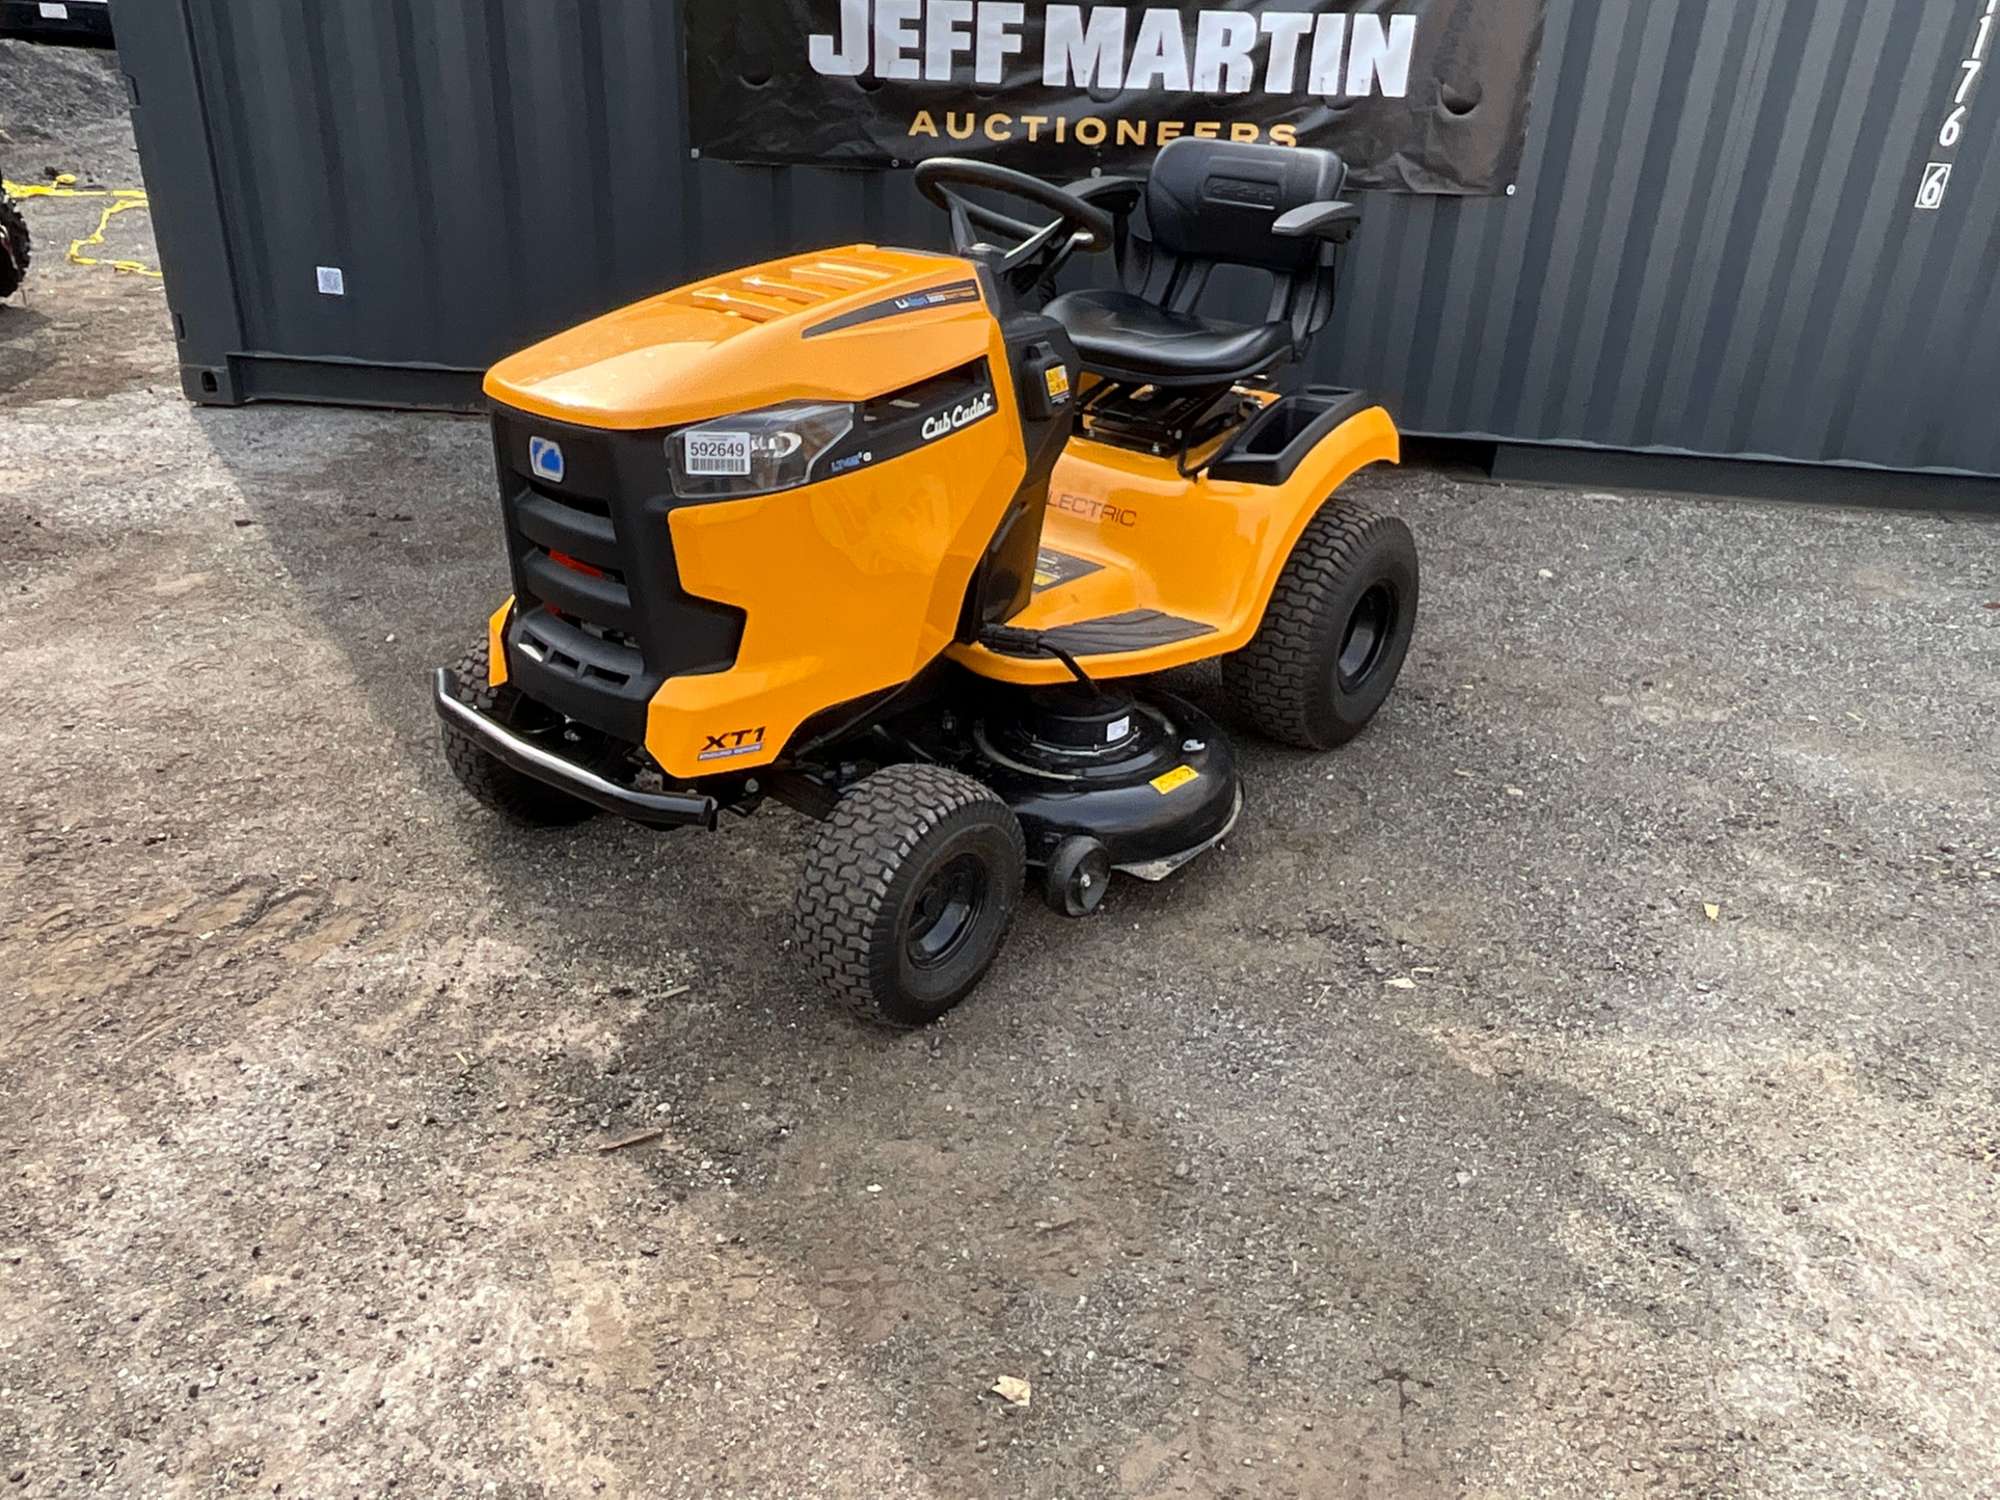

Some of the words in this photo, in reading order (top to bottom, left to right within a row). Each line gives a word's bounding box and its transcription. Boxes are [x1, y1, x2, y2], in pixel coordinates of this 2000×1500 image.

[809, 0, 1024, 83] JEFF
[1043, 4, 1416, 98] MARTIN
[922, 411, 951, 440] Cub
[952, 392, 993, 428] Cadet
[690, 442, 745, 457] 592649
[1046, 491, 1137, 527] LECTRIC
[701, 726, 766, 751] XT1
